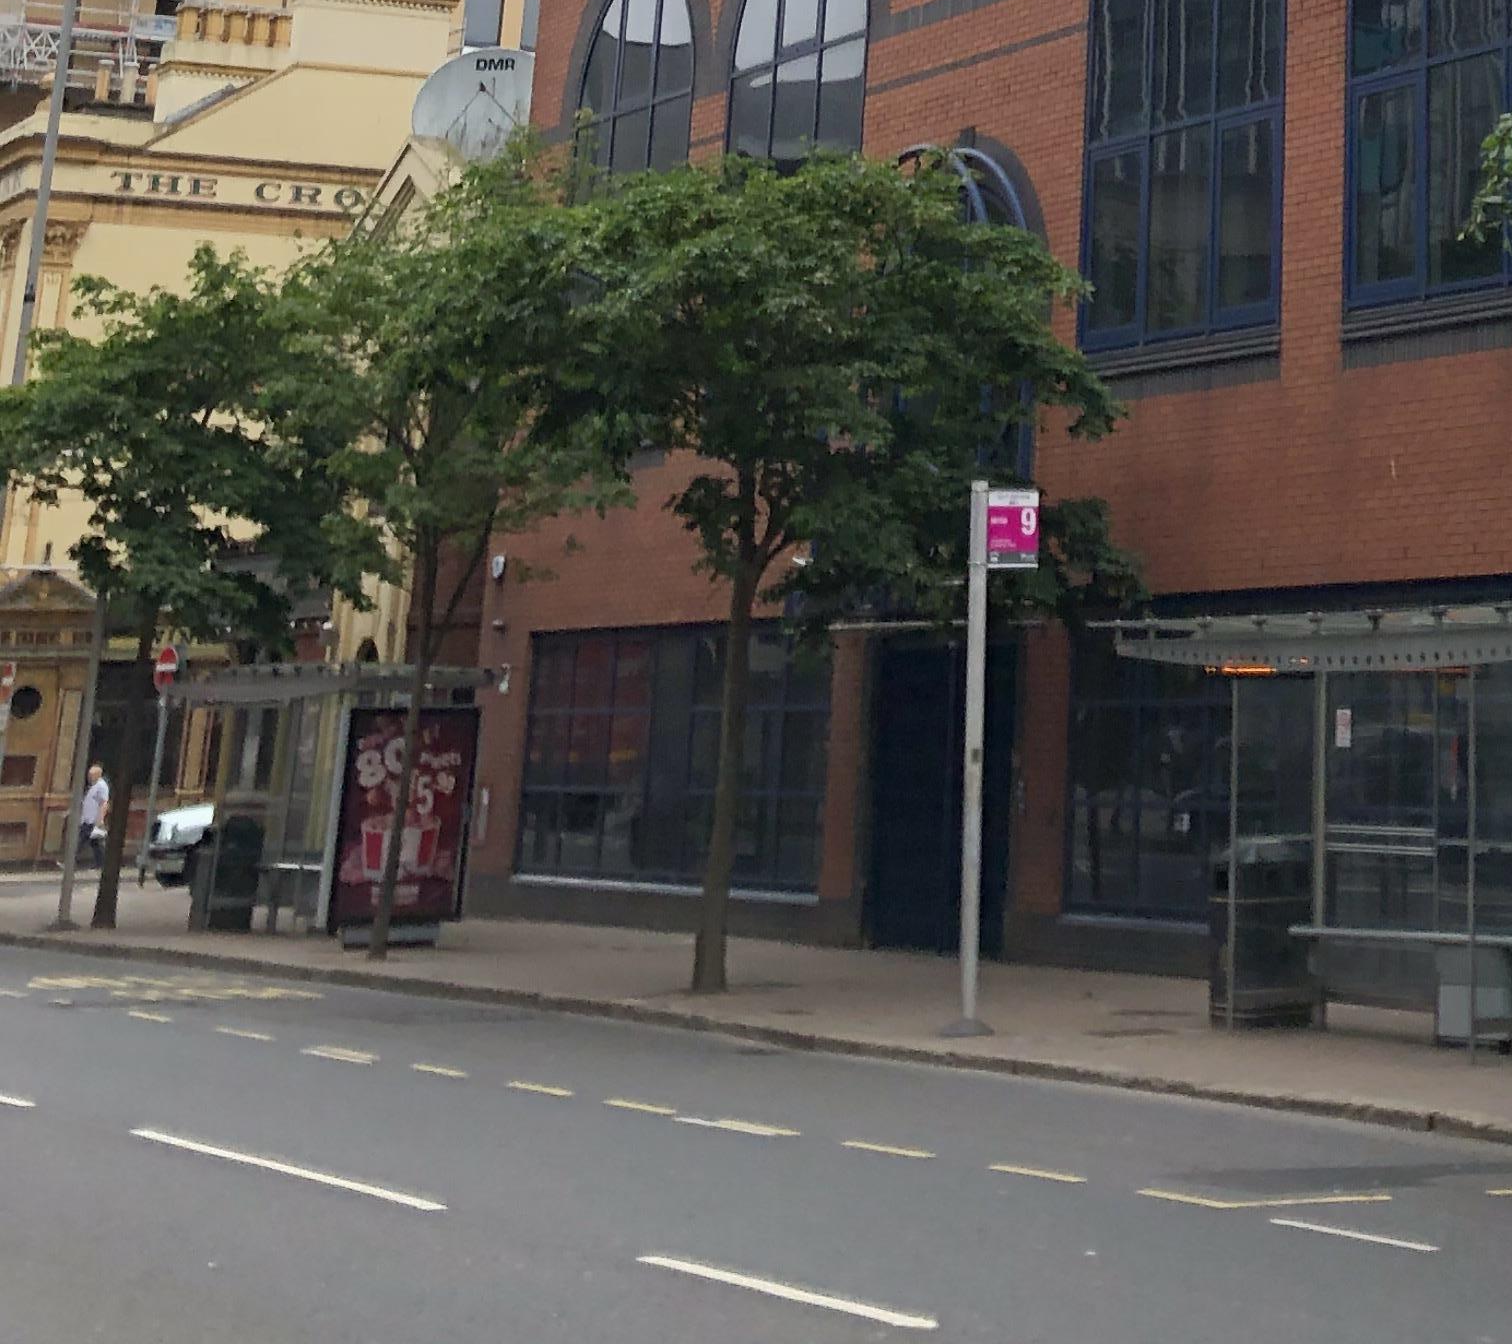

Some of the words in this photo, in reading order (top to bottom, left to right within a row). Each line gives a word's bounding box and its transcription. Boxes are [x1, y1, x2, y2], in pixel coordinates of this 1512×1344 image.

[111, 169, 218, 199] THE
[254, 181, 365, 211] CRO
[1021, 507, 1037, 536] 9
